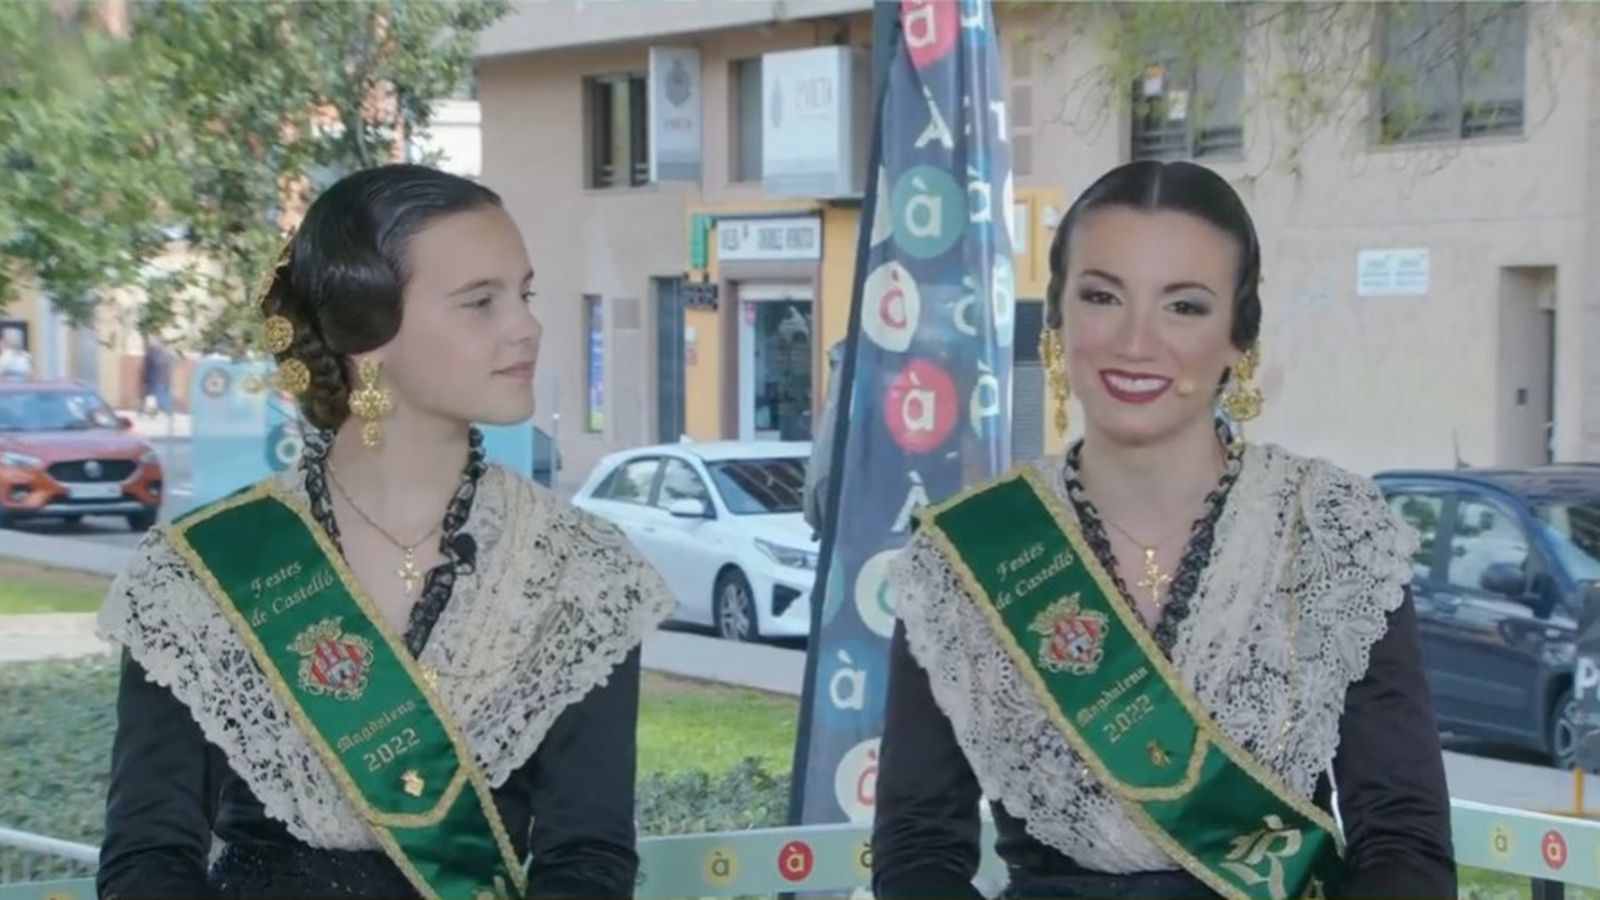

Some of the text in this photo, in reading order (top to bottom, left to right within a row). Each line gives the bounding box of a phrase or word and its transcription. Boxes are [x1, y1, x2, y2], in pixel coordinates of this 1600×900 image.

[904, 176, 942, 237] à
[902, 371, 936, 431] à
[250, 561, 302, 599] Festes
[997, 541, 1045, 583] Festes
[251, 606, 268, 628] de
[829, 649, 867, 711] à
[1102, 694, 1155, 744] 2022
[362, 727, 420, 773] 2022
[786, 846, 806, 873] à
